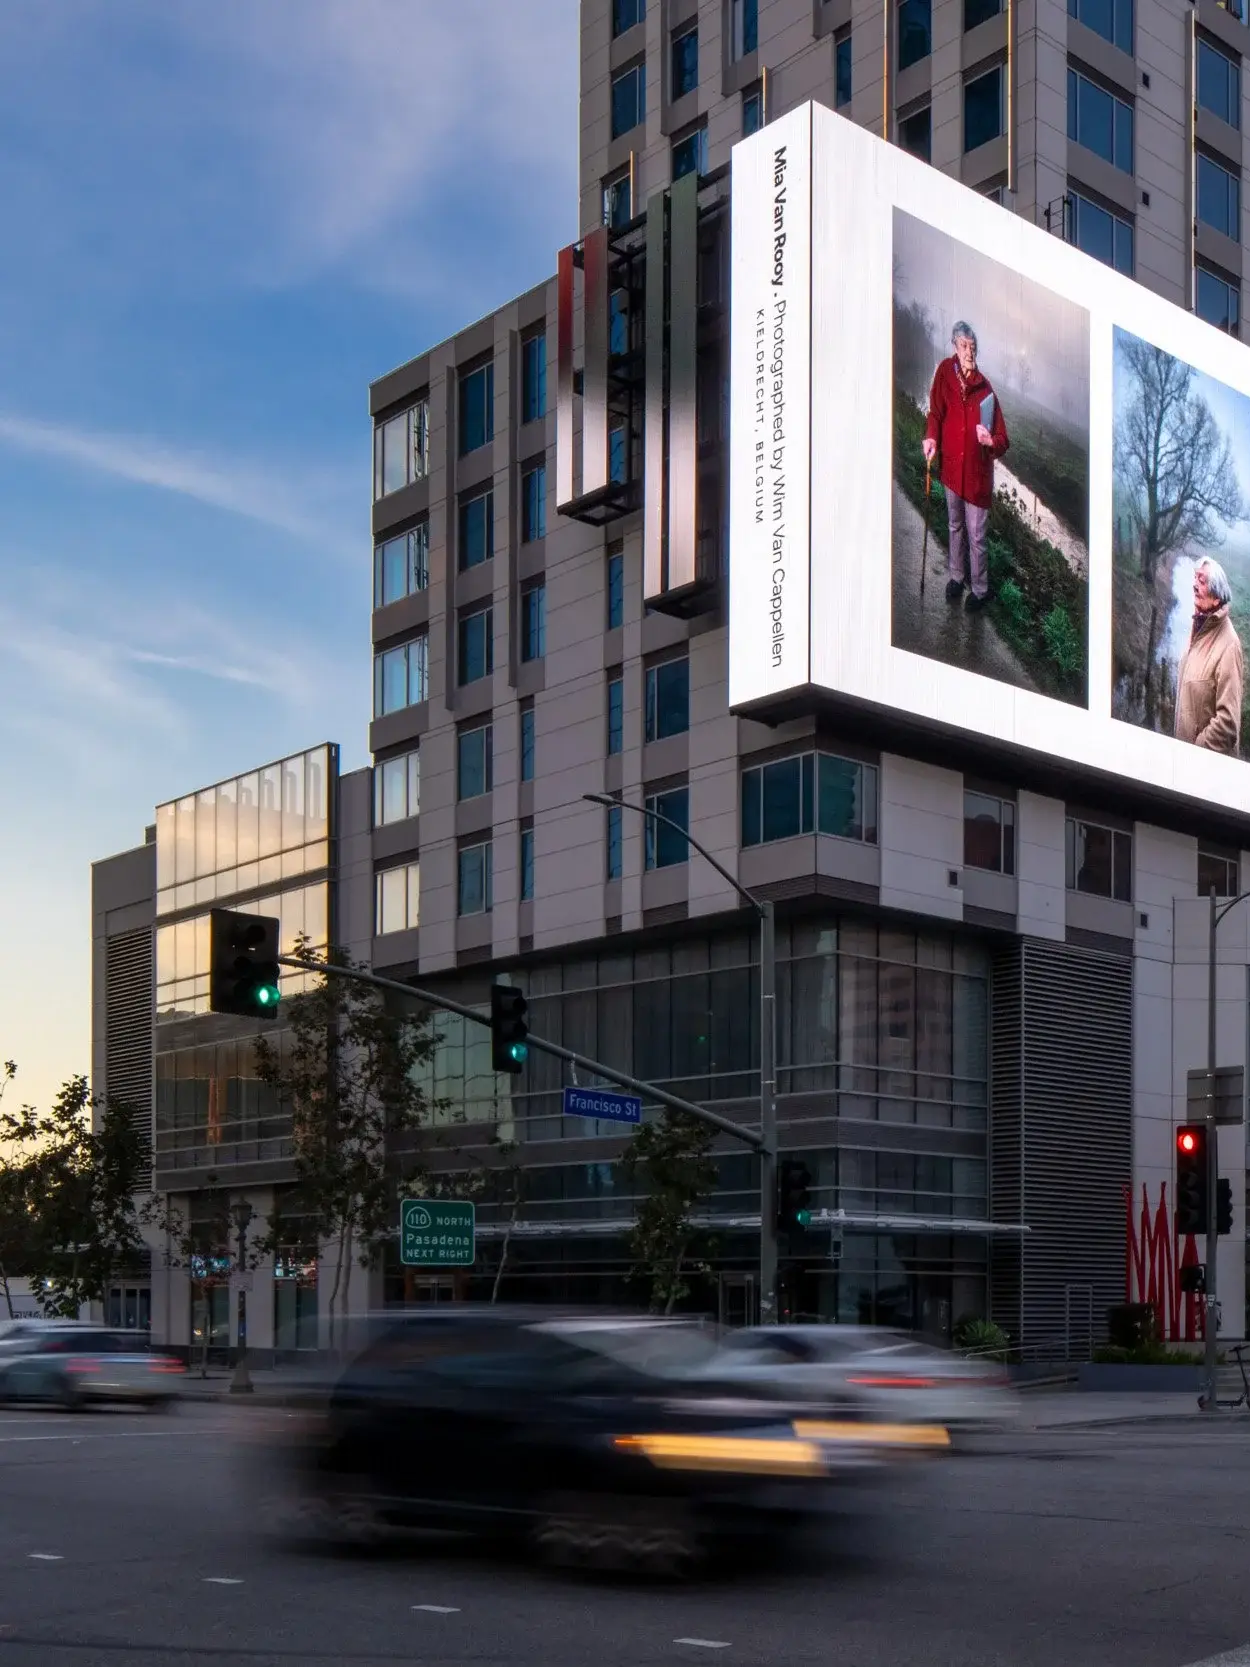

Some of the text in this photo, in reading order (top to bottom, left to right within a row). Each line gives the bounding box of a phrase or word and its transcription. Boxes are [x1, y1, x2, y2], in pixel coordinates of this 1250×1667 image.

[773, 145, 787, 187] Mia
[773, 187, 787, 232] Van
[770, 232, 787, 287] Rooy
[770, 299, 787, 443] Photographed
[769, 445, 786, 471] by
[755, 440, 764, 524] BELGIUM
[772, 474, 786, 521] Wim
[772, 523, 786, 564] Van
[769, 568, 786, 668] Cappellen
[569, 1094, 636, 1116] Francisco St
[406, 1233, 470, 1246] Pasadena
[410, 1214, 471, 1226] 110 NORTH
[406, 1249, 469, 1258] NEXT RIGHT
